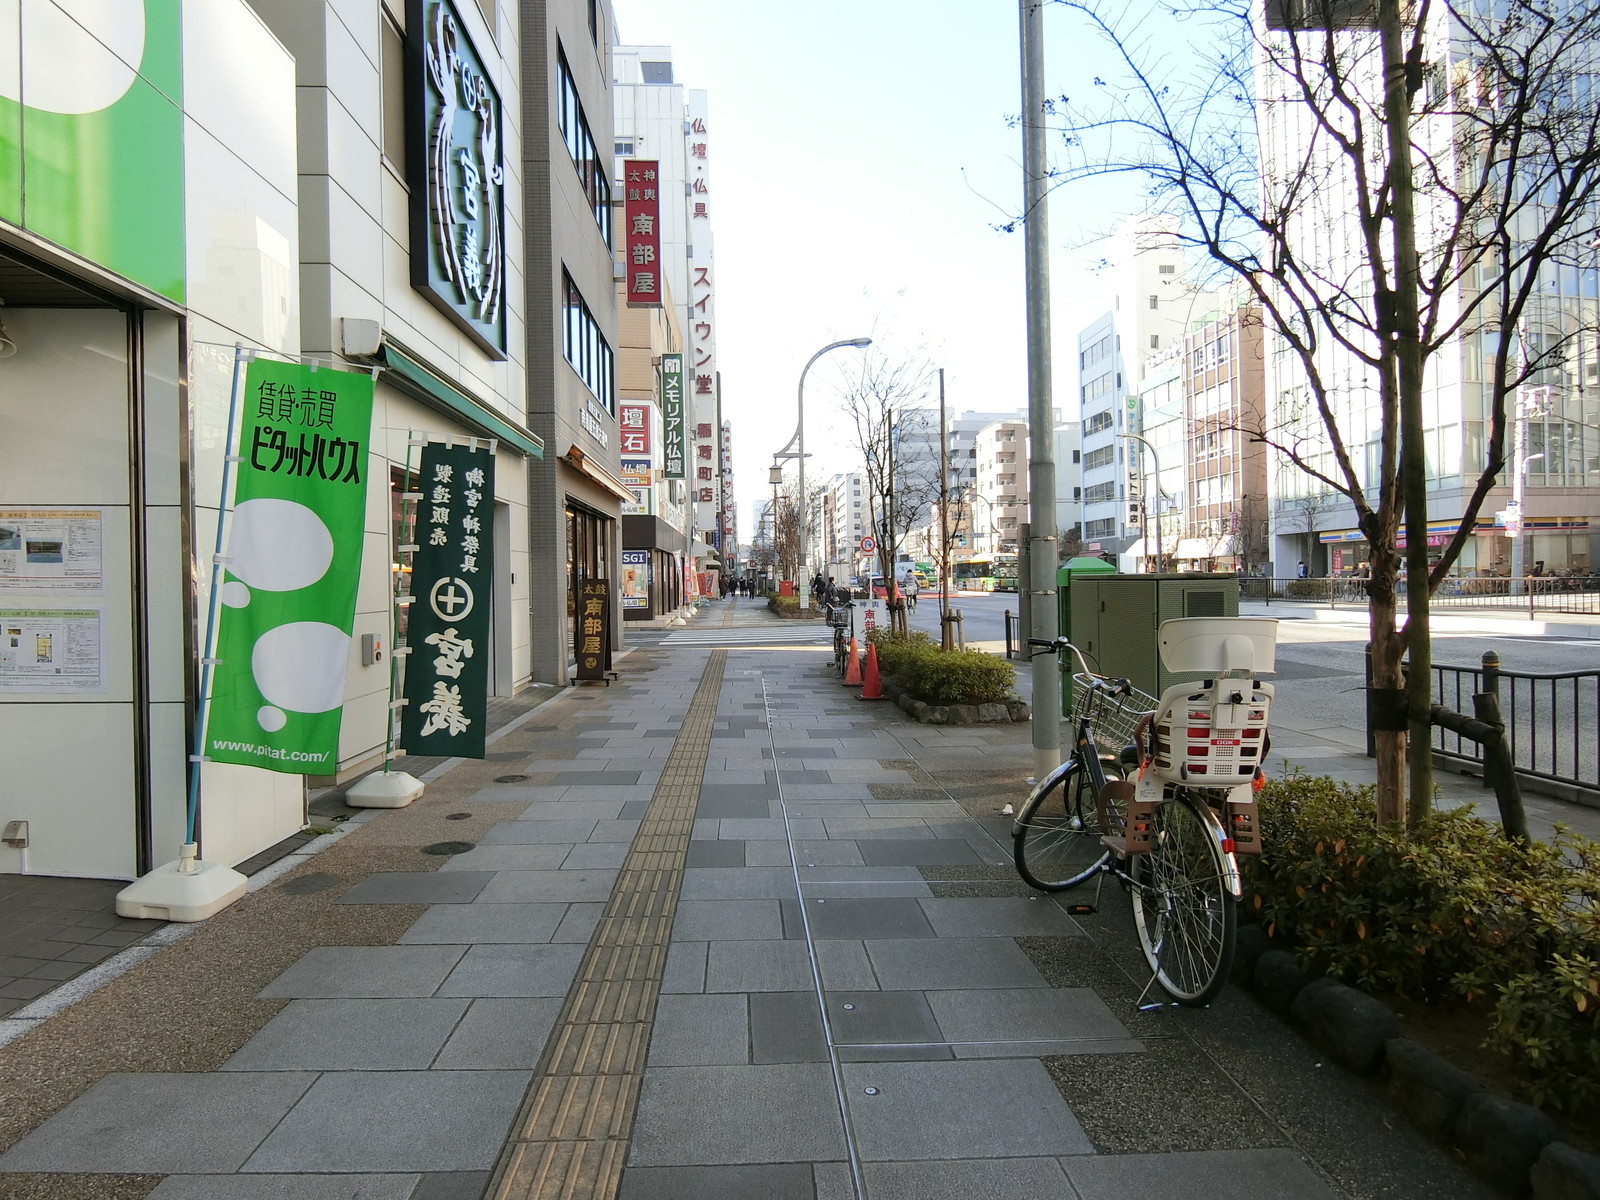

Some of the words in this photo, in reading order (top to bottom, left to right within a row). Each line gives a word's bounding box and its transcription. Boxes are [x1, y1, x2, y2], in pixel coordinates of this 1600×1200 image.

[691, 117, 708, 219] 仏壇・仏具
[631, 212, 656, 295] 南部屋
[693, 267, 713, 395] スイウン堂
[257, 380, 337, 431] 賃貸・売買
[620, 408, 644, 428] 壇
[665, 375, 683, 473] メモリアル仏壇
[251, 425, 360, 485] ピタットハウス
[620, 433, 645, 452] 石
[622, 463, 647, 475] 仏壇
[697, 422, 713, 503] 稲荷町店
[583, 584, 607, 595] 太鼓
[582, 597, 604, 654] 南部屋
[213, 740, 330, 763] www.pitat.com/
